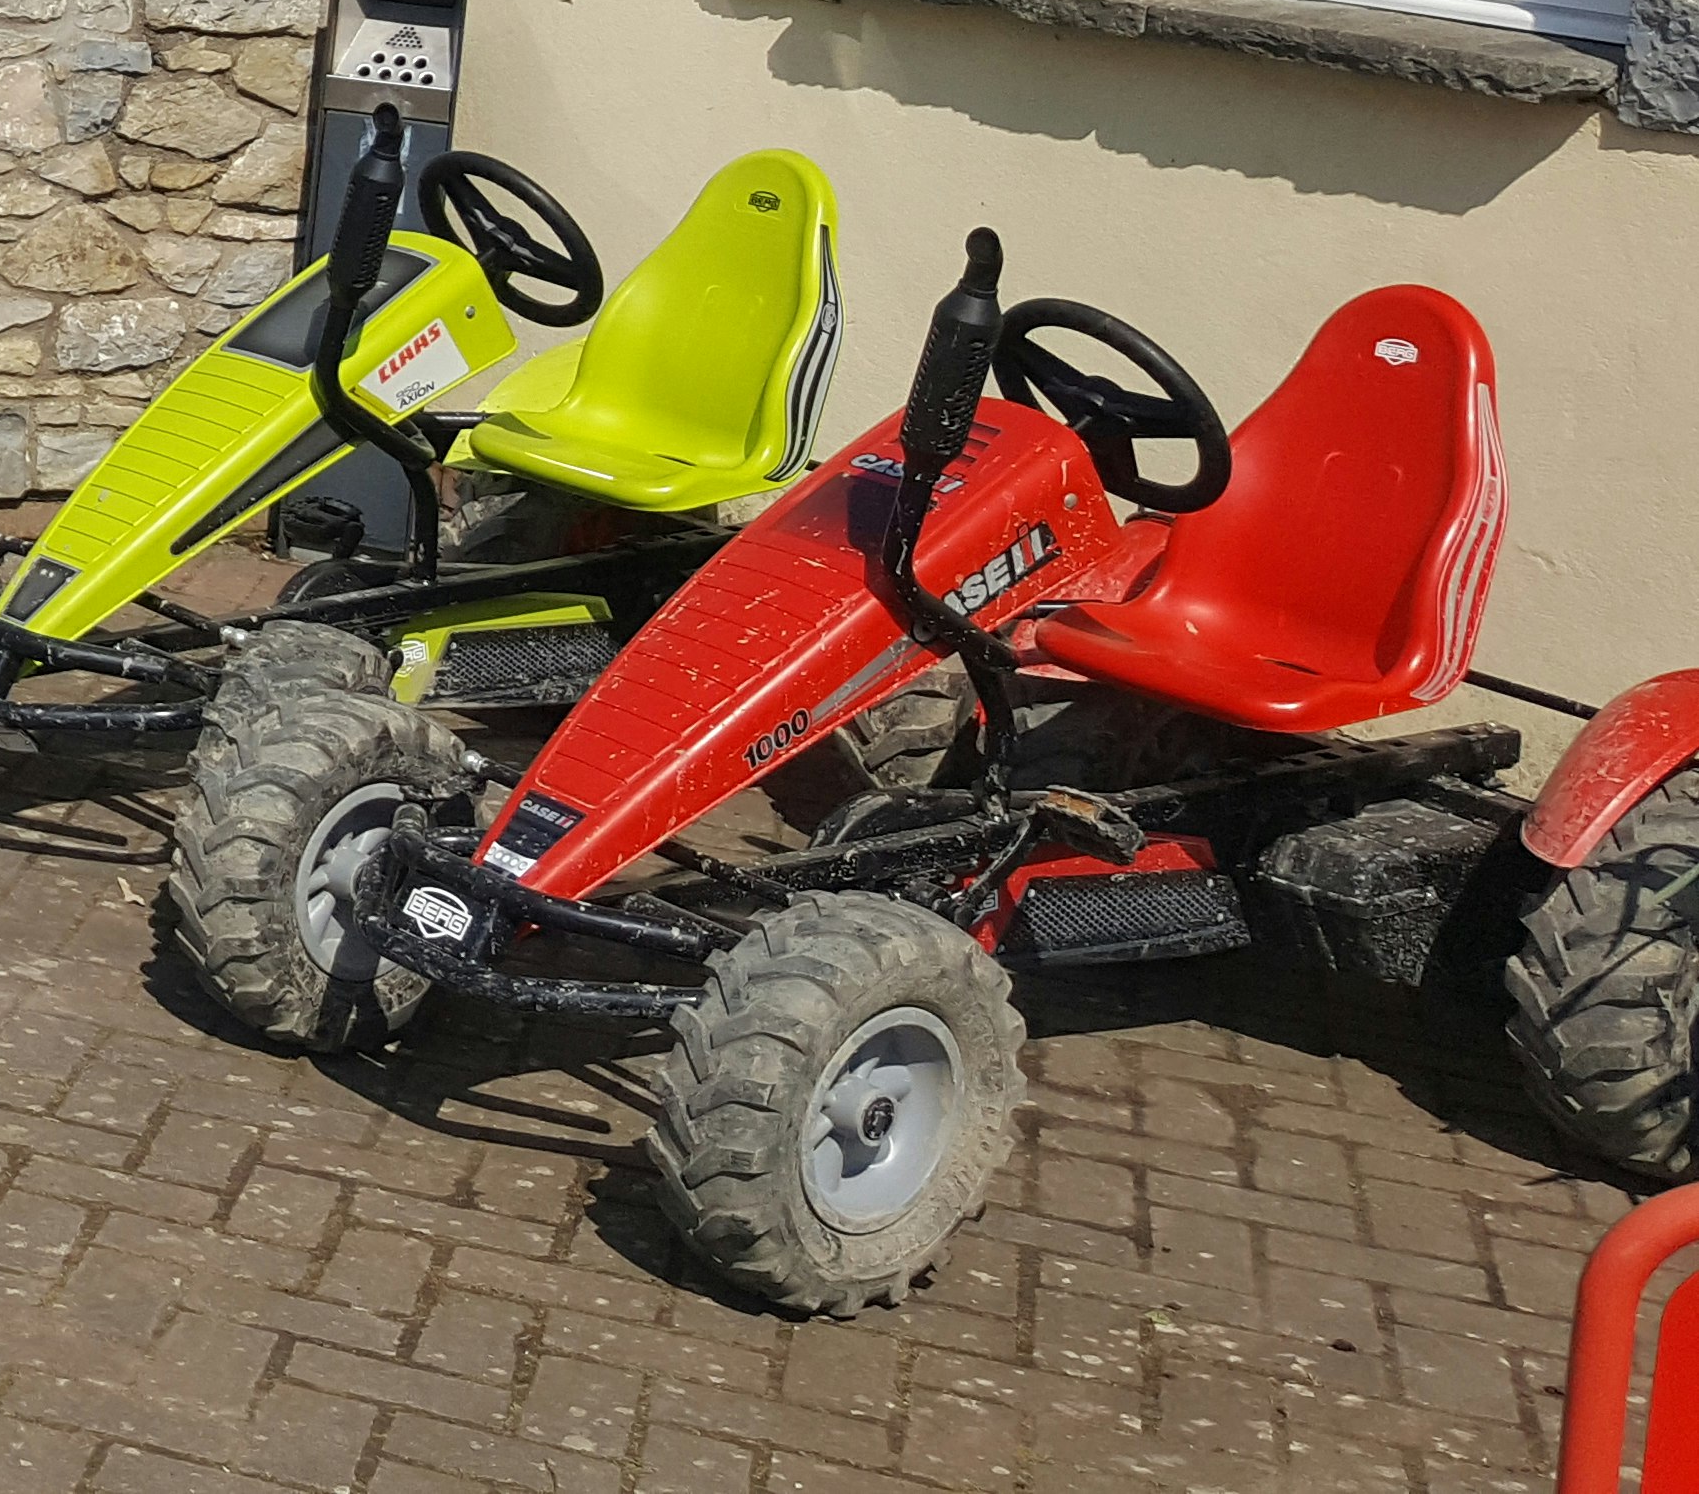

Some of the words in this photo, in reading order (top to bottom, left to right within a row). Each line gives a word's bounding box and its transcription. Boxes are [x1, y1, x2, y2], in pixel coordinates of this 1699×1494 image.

[377, 322, 441, 385] CLAAS
[1377, 345, 1415, 360] BERG
[399, 380, 435, 409] AXION
[742, 707, 810, 772] 1000
[519, 799, 556, 822] CASE
[408, 895, 467, 935] BERG
